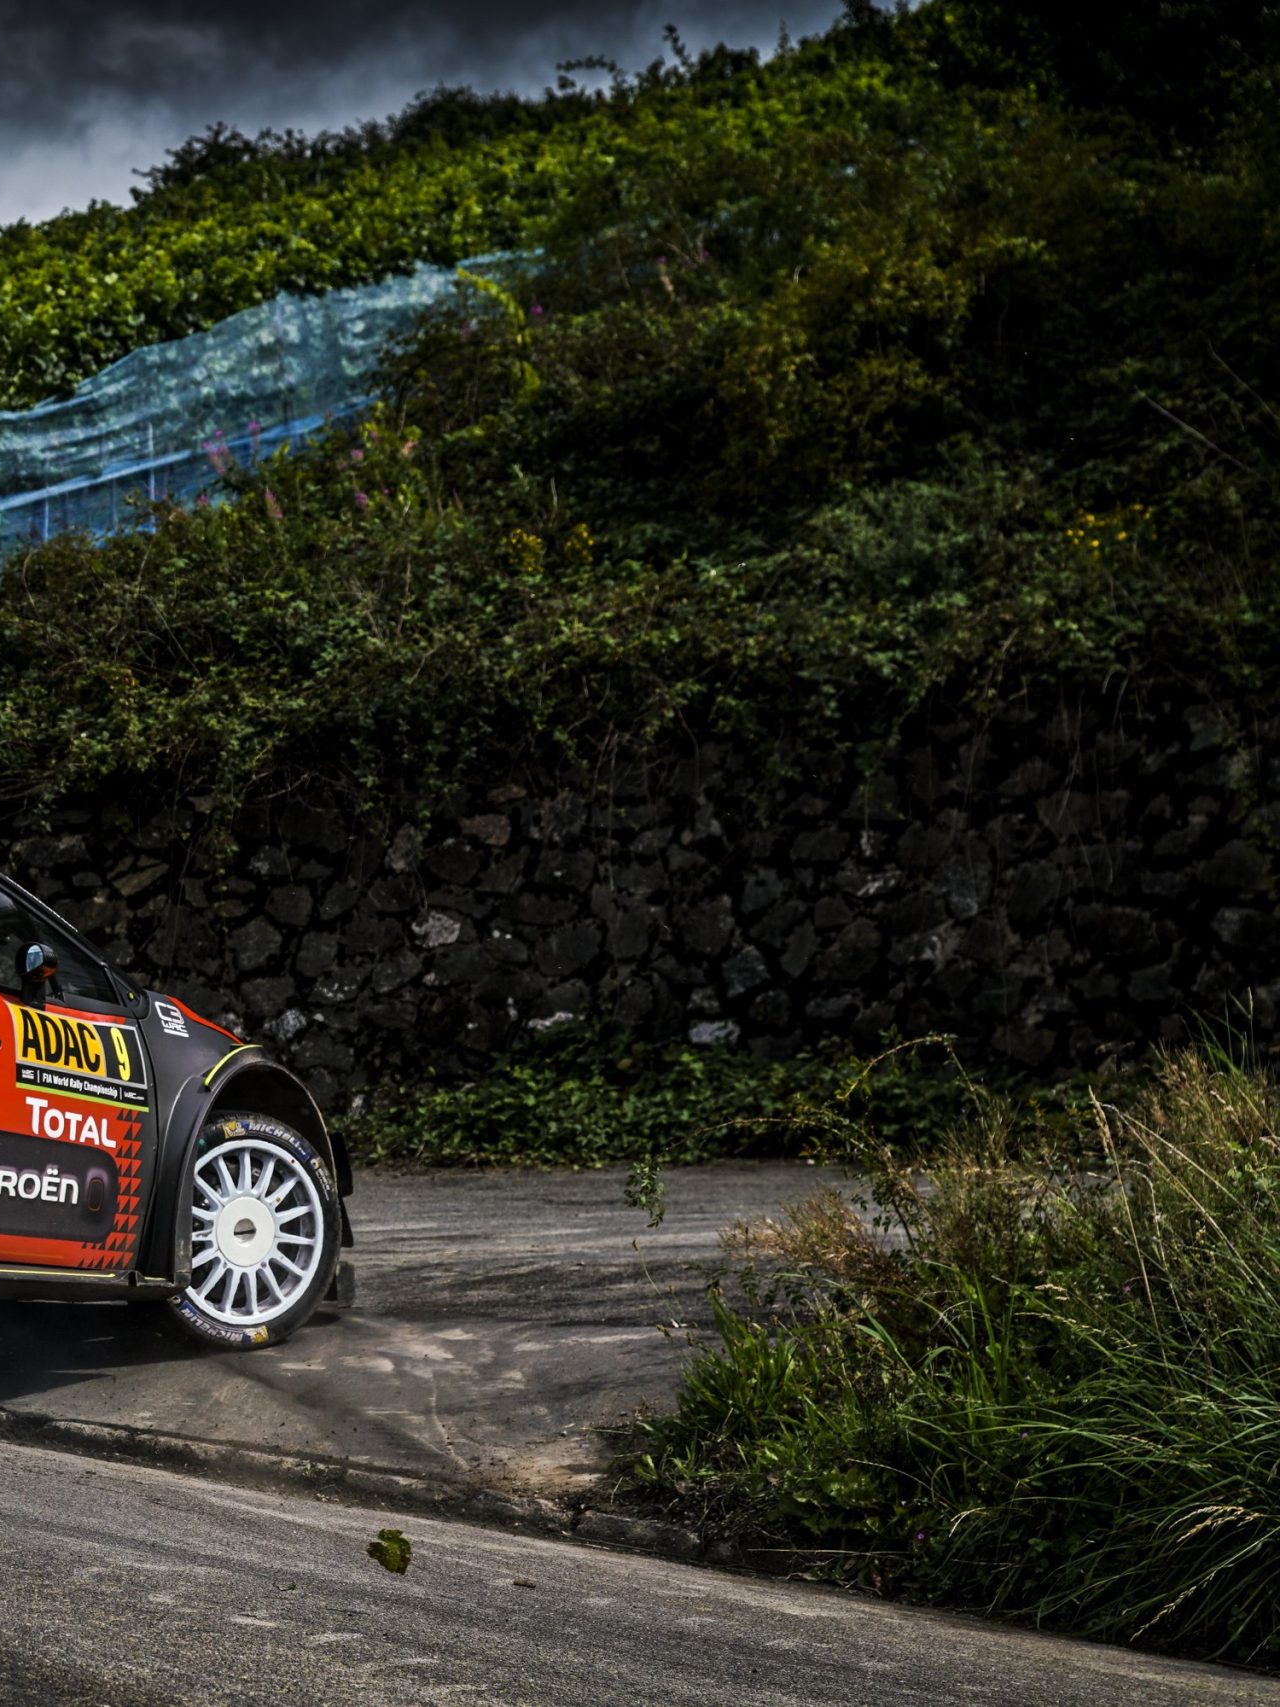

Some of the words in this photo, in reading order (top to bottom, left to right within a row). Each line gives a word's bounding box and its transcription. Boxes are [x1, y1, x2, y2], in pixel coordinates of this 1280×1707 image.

[154, 1000, 185, 1025] C3
[162, 1020, 188, 1033] WRC
[19, 1007, 101, 1073] ADAC
[110, 1026, 131, 1082] 9
[42, 1073, 52, 1083] FIA
[53, 1074, 69, 1087] World
[70, 1079, 83, 1091] Rally
[84, 1081, 118, 1099] Championship
[25, 1096, 117, 1149] TOTAL
